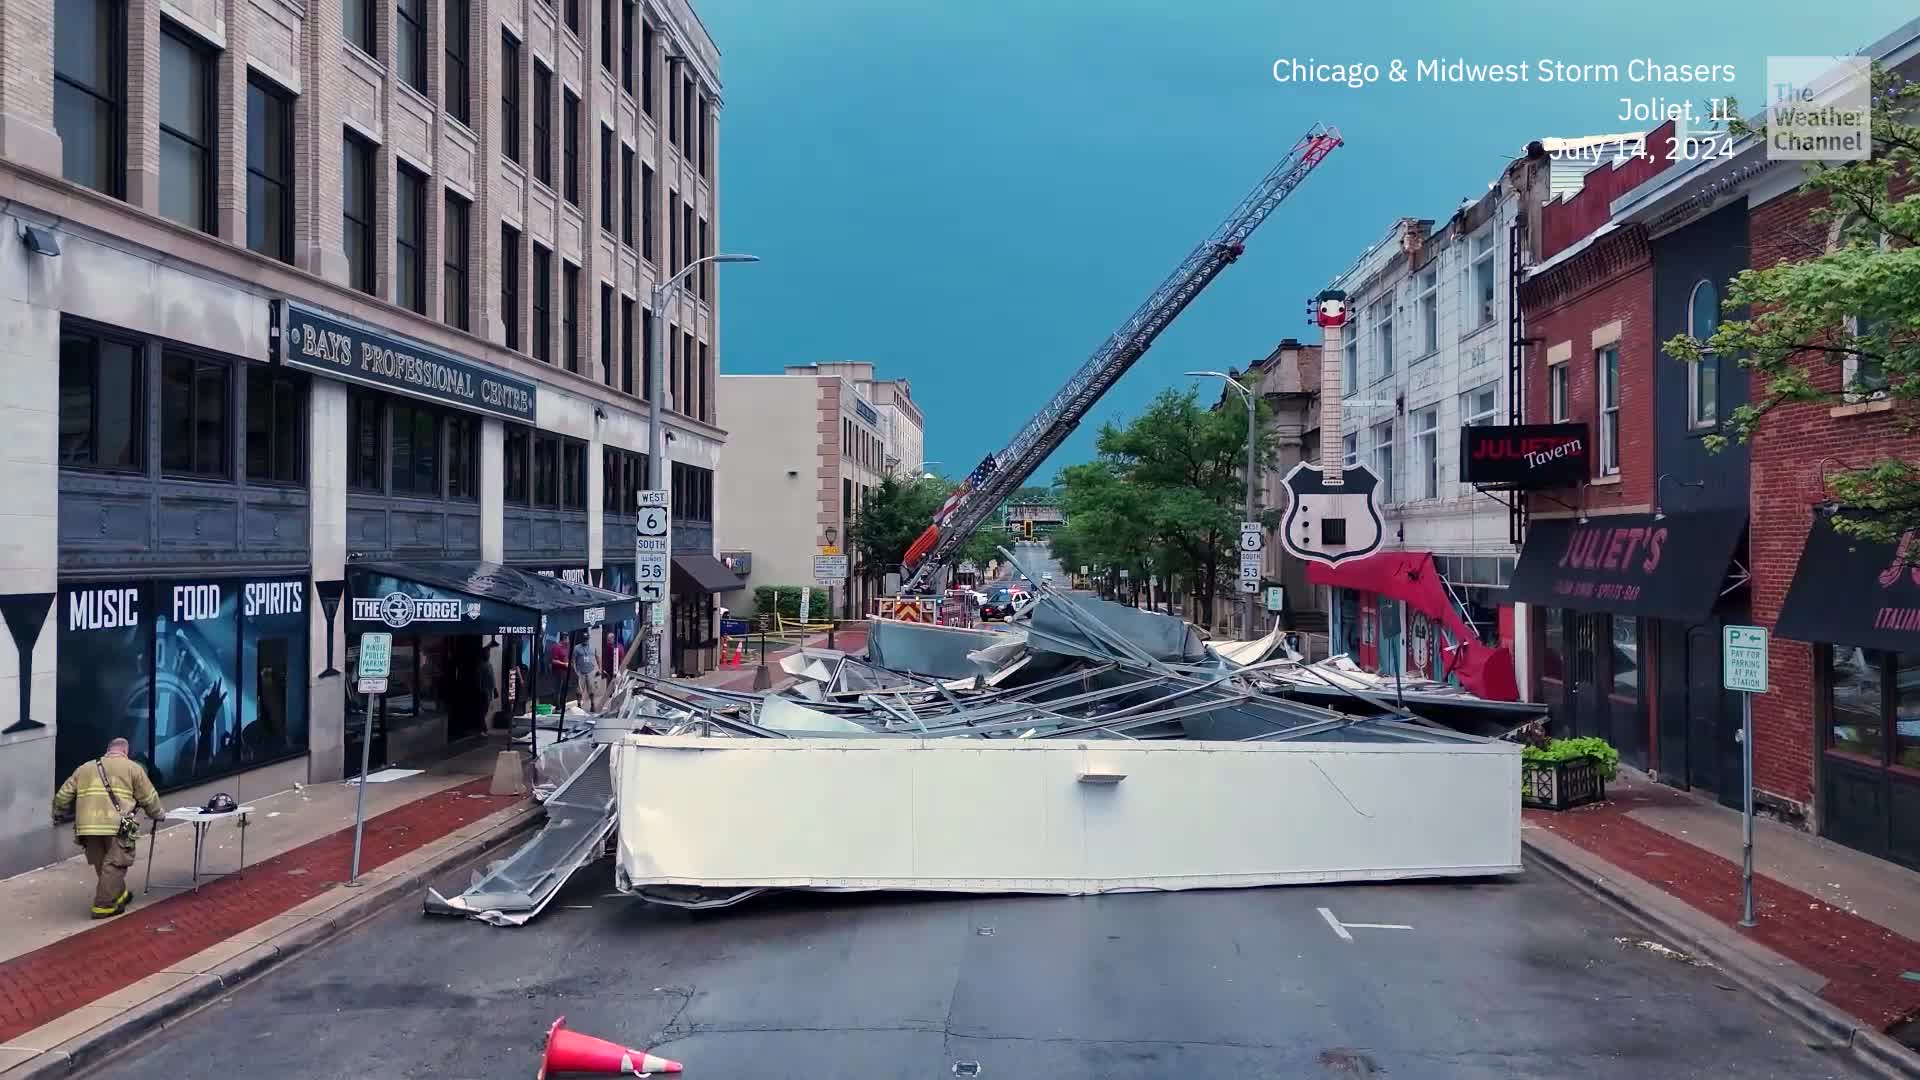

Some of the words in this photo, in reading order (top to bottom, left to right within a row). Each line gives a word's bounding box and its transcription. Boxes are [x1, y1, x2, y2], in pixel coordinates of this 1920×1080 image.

[302, 323, 351, 367] BAYS
[360, 342, 475, 399] PROFESSIONAL
[480, 378, 528, 412] CENTRE
[1523, 438, 1583, 469] Tavern
[642, 492, 665, 502] WEST
[646, 513, 658, 529] 6
[638, 539, 666, 549] SOUTH
[1247, 536, 1255, 547] 6
[1558, 527, 1669, 574] JULIET'S
[1243, 567, 1258, 577] 53
[173, 584, 220, 622] FOOD
[244, 581, 302, 616] SPIRITS
[69, 588, 138, 631] MUSIC
[357, 601, 380, 617] THE
[416, 602, 458, 618] FORGE
[1730, 630, 1741, 644] P
[1731, 650, 1743, 658] PAY
[1747, 650, 1760, 659] FOR
[1731, 659, 1760, 669] PARKING
[1735, 668, 1742, 678] AT
[1745, 669, 1757, 678] PAY
[1732, 678, 1760, 687] STATION
